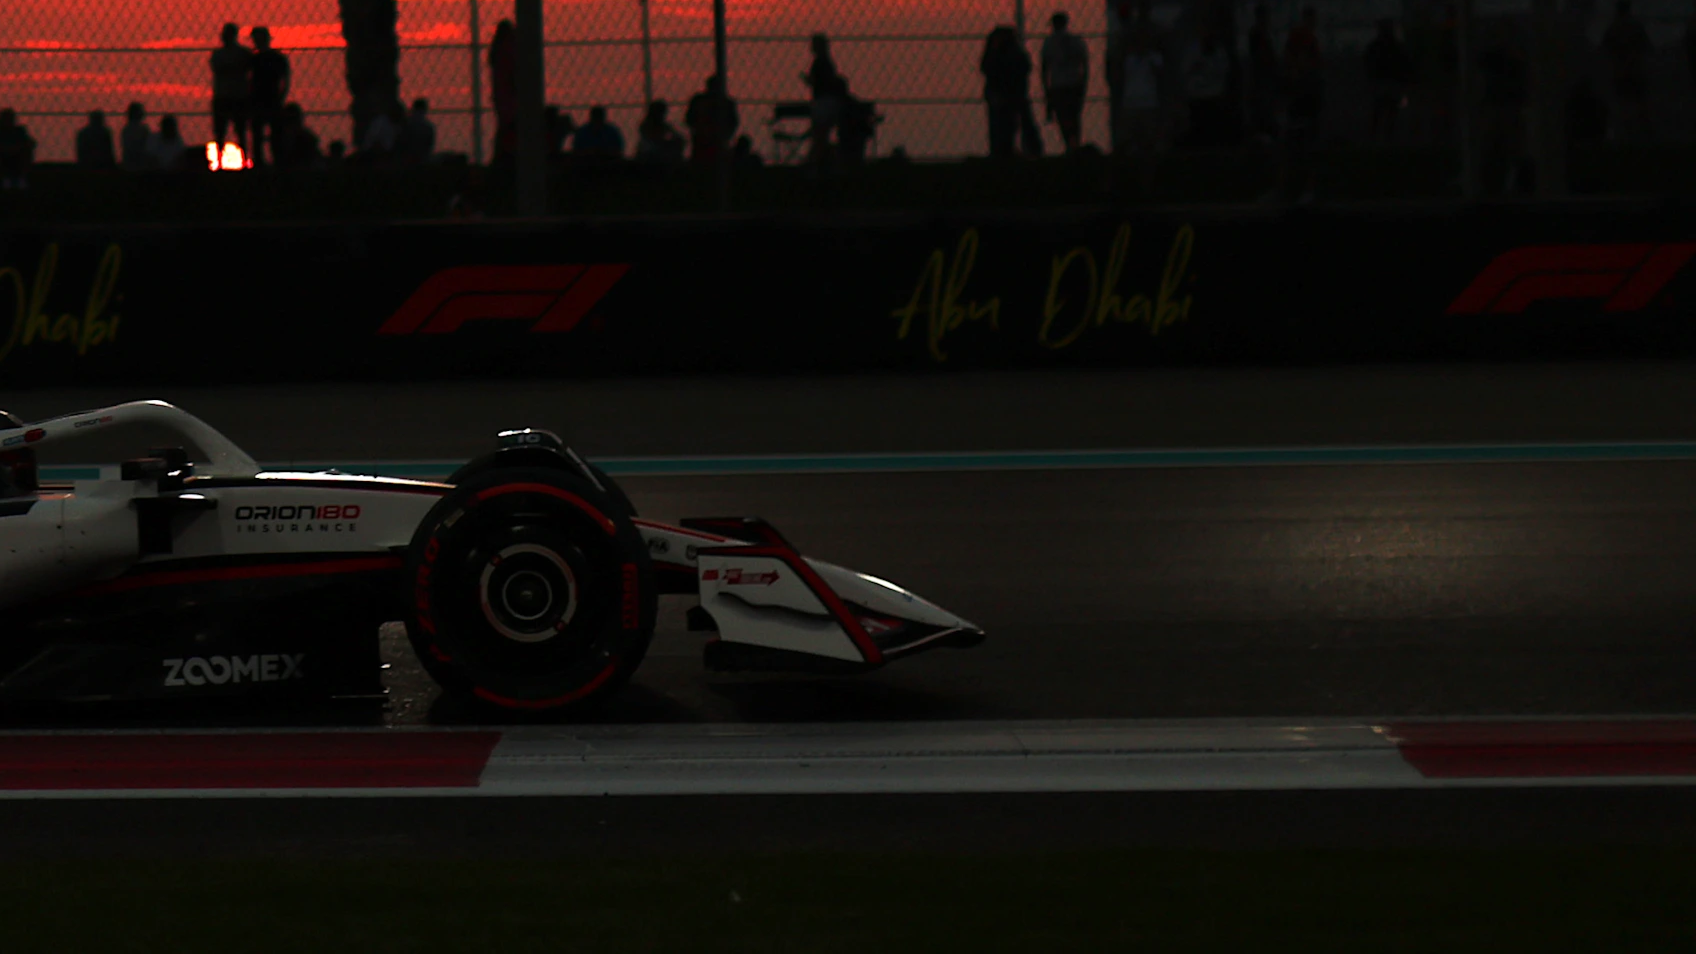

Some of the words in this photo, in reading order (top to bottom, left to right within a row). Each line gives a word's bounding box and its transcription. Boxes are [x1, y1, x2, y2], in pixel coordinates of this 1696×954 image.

[378, 263, 632, 336] F1
[890, 225, 1000, 364] Abu
[1036, 222, 1198, 350] Dhabi
[235, 505, 362, 520] ORION180
[237, 523, 358, 533] INSURANCE
[163, 653, 304, 687] ZOOMEX
